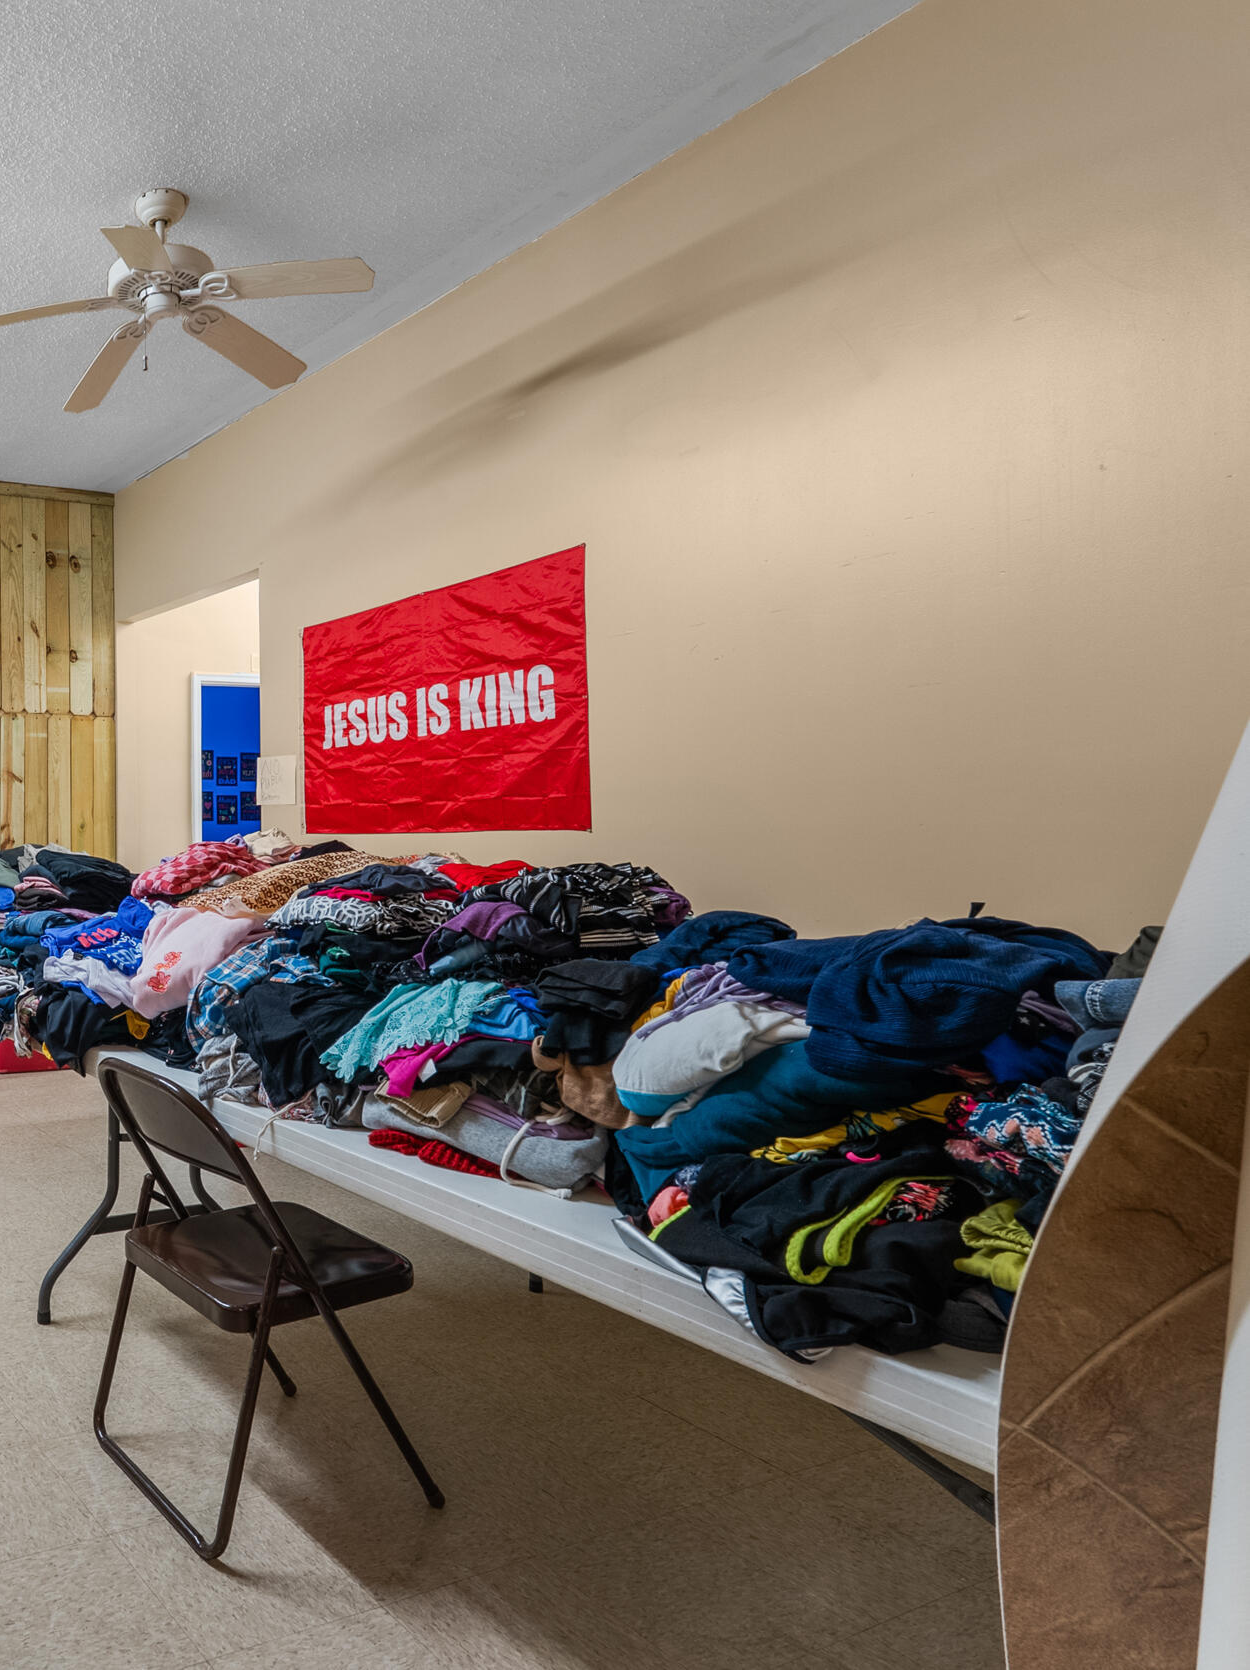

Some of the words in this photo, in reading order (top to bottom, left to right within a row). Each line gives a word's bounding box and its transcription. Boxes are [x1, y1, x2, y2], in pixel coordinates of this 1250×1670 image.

[322, 690, 408, 750] JESUS
[416, 683, 450, 738] IS
[459, 664, 556, 732] KING
